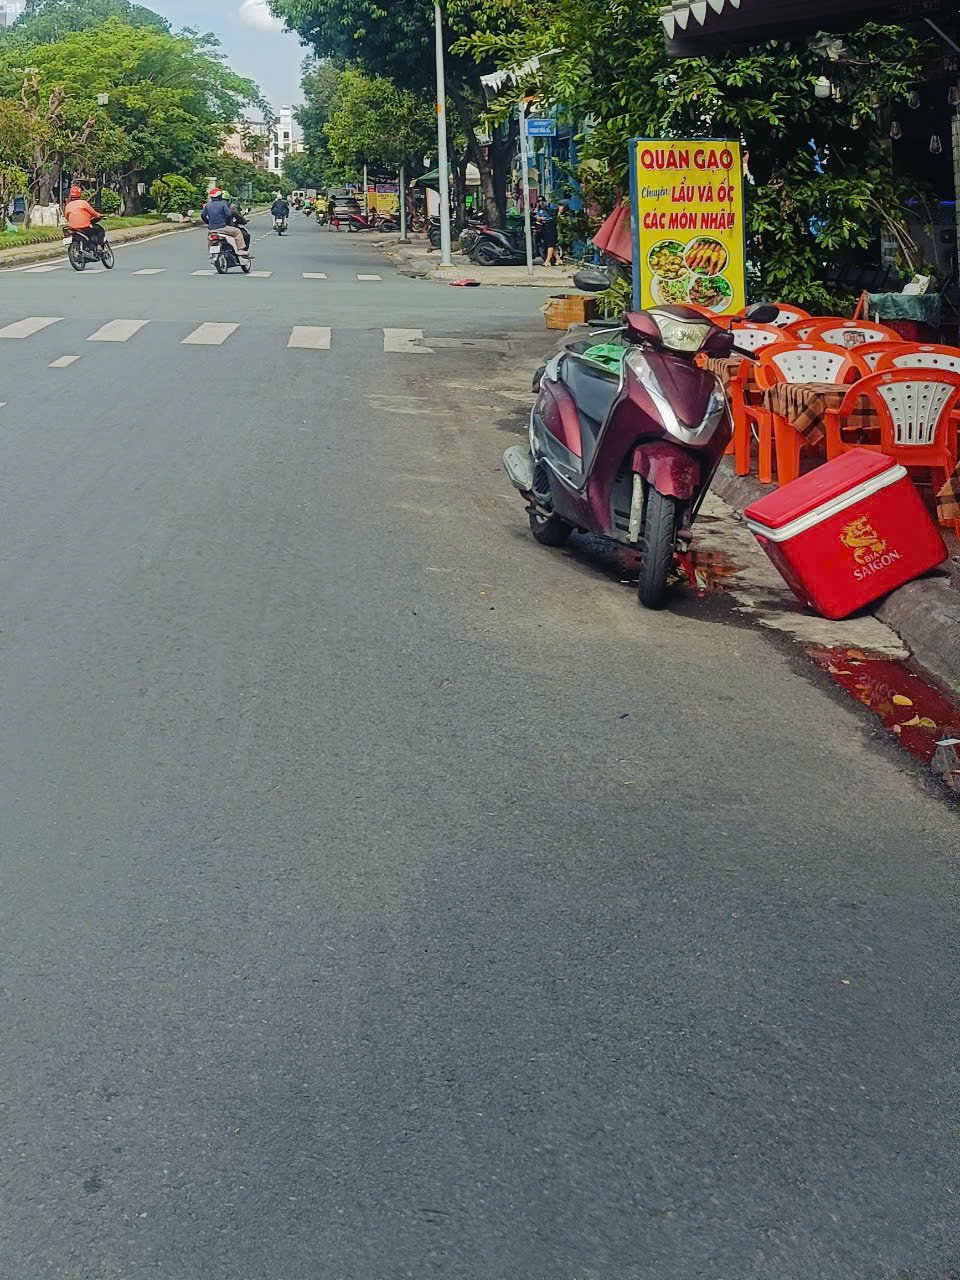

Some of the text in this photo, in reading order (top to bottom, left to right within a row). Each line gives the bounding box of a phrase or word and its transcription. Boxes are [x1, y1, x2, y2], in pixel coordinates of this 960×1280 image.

[640, 144, 735, 174] QUÁN GẠO
[671, 176, 695, 203] LẨU
[698, 181, 714, 203] VÀ
[718, 177, 735, 203] ỐC
[643, 207, 666, 230] CÁC
[669, 207, 698, 230] MÓN
[853, 549, 901, 581] SAIGON
[863, 552, 880, 563] BIA
